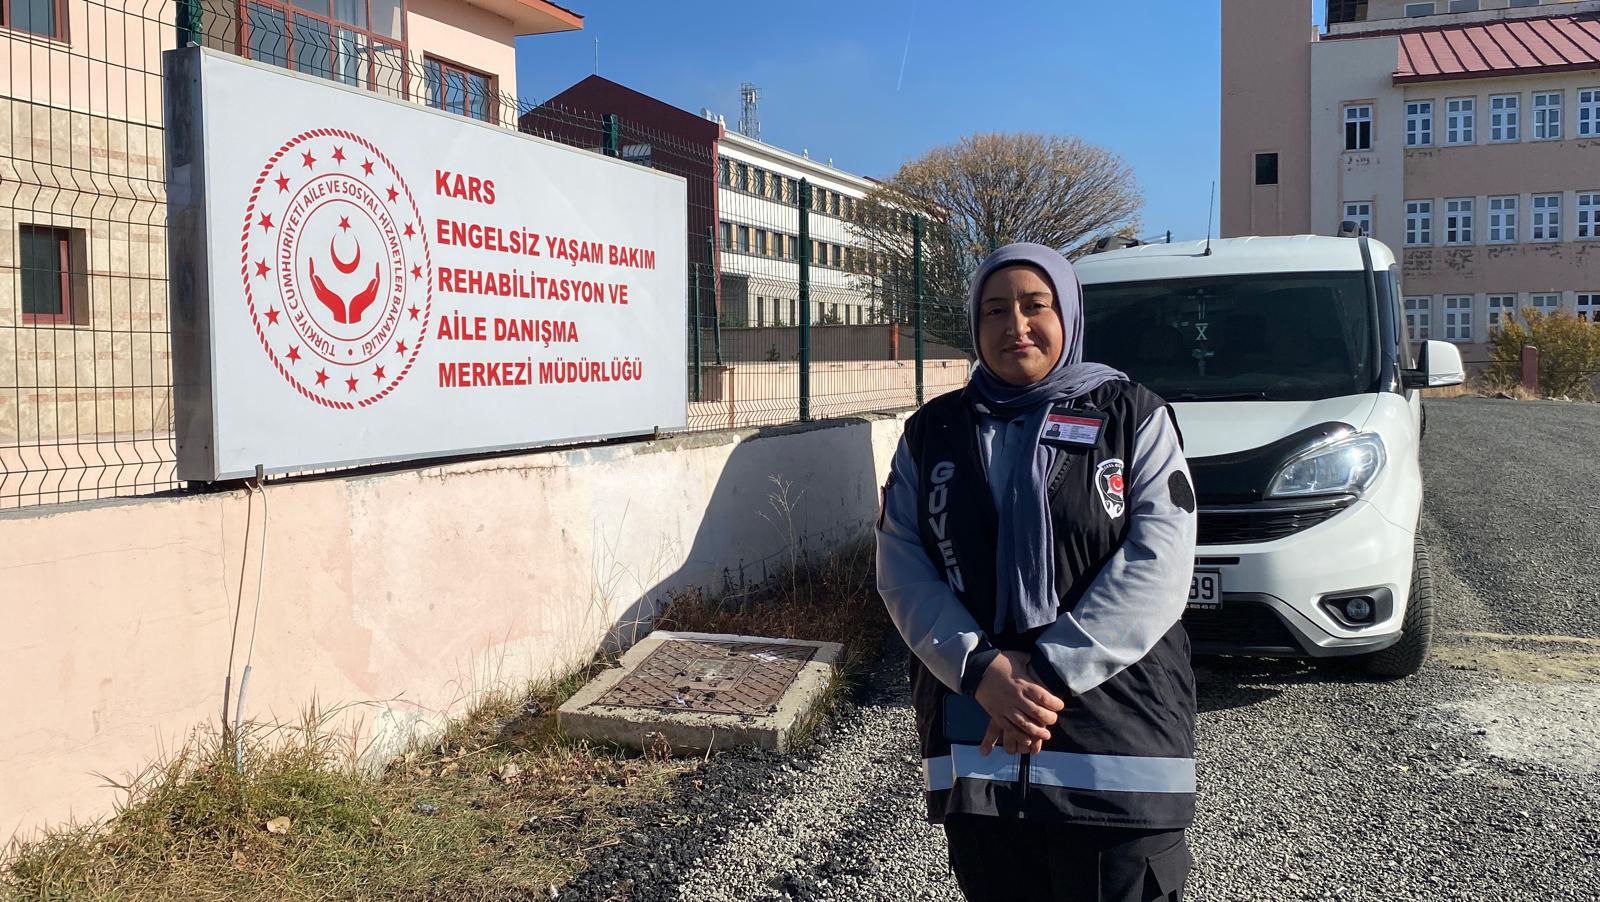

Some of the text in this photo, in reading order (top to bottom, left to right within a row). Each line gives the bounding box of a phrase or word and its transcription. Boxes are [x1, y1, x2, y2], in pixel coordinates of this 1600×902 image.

[435, 169, 496, 205] KARS
[436, 218, 656, 270] ENGELSİZ YAŞAM BAKIM
[281, 180, 404, 357] TÜRKİYE CUMHURİYETİ AİLE VE SOSYAL HİZMETLER BAKANLIĞI
[438, 266, 629, 305] REHABİLİTASYON VE
[437, 309, 579, 349] AİLE DANIŞMA
[438, 356, 643, 388] MERKEZİ MÜDÜRLÜĞÜ
[928, 461, 965, 593] GÜVEN
